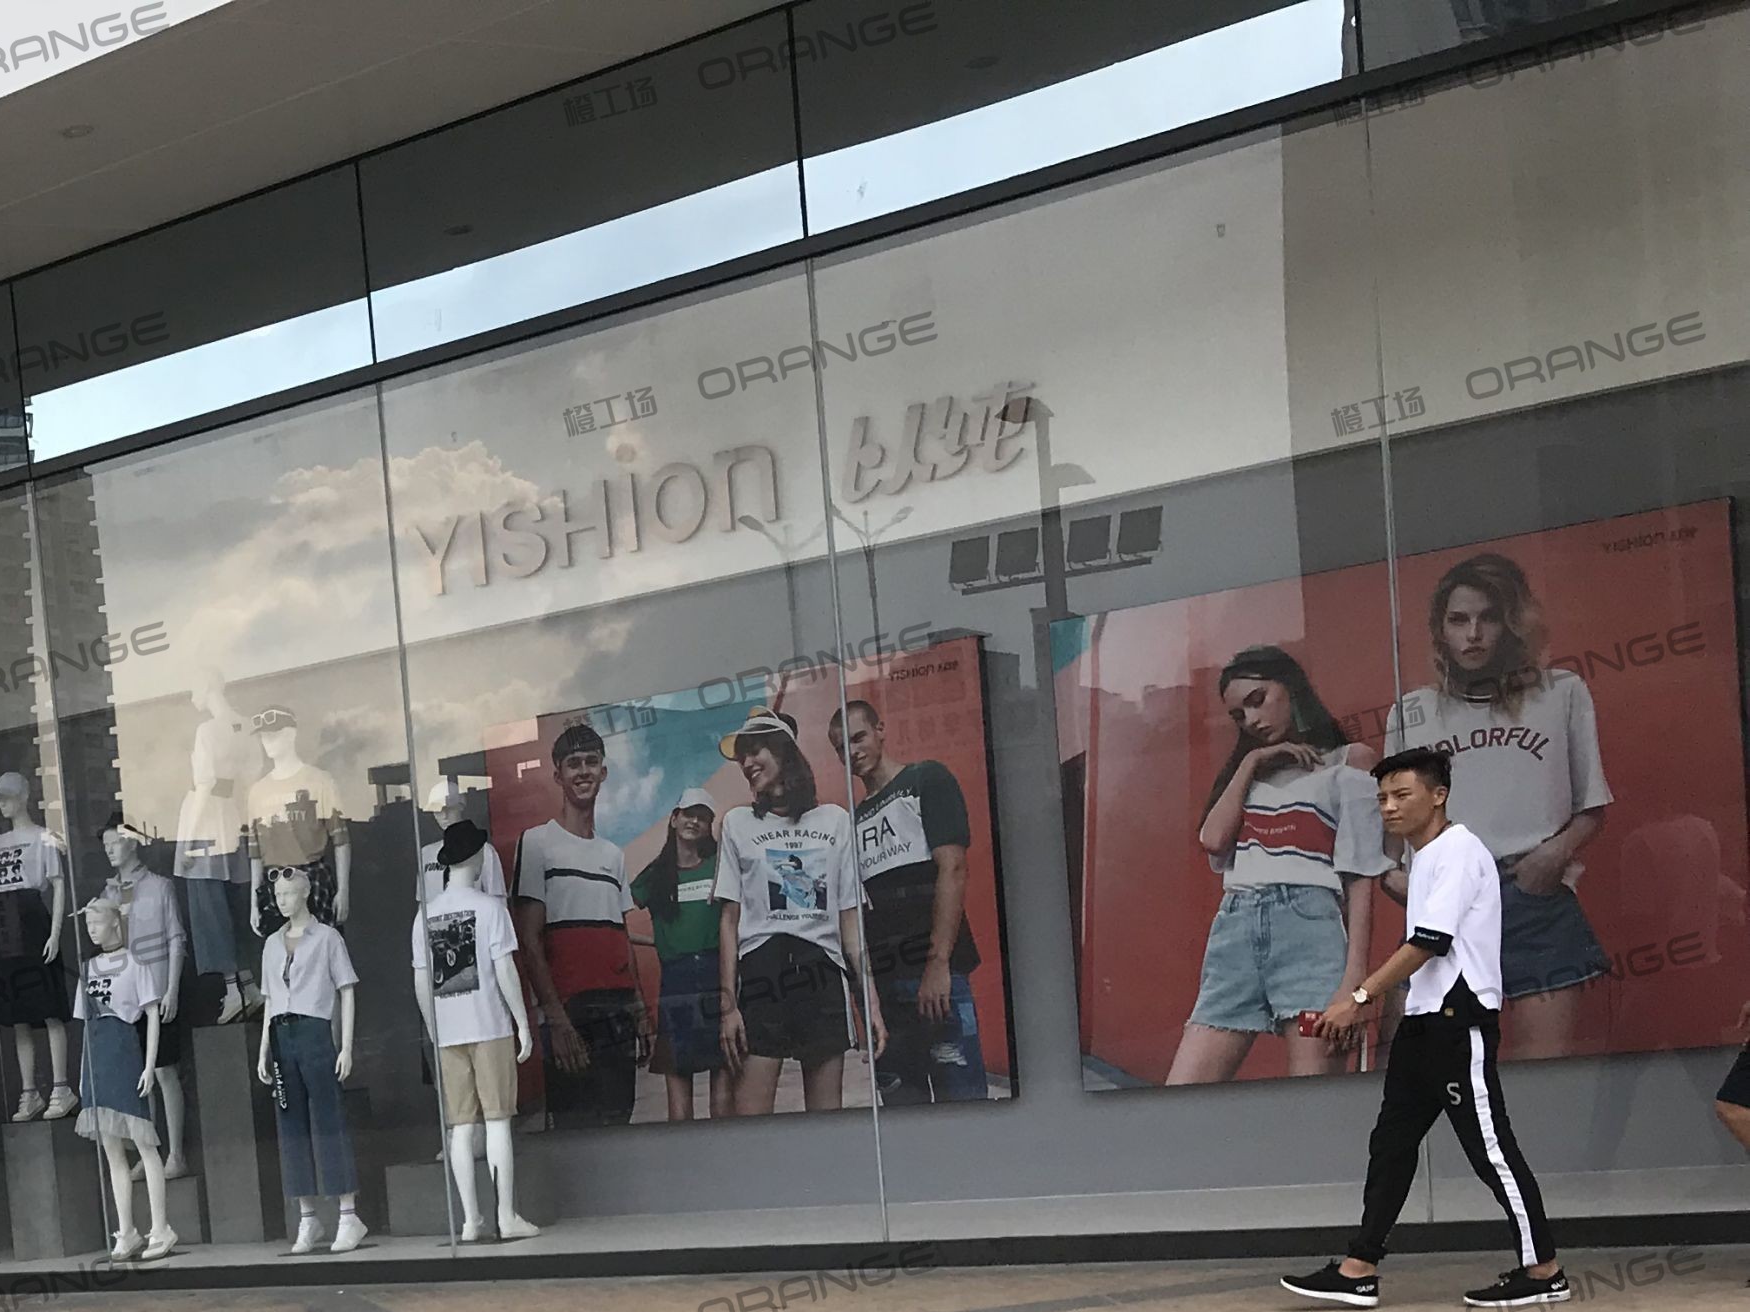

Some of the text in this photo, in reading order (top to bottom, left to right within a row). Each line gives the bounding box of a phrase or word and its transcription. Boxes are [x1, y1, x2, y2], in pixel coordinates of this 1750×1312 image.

[841, 380, 1038, 504] 以纯
[1421, 726, 1550, 762] OLORFUL
[751, 829, 837, 847] LINEAR RACING
[859, 841, 912, 870] YOUR WAY
[1446, 1082, 1462, 1106] S
